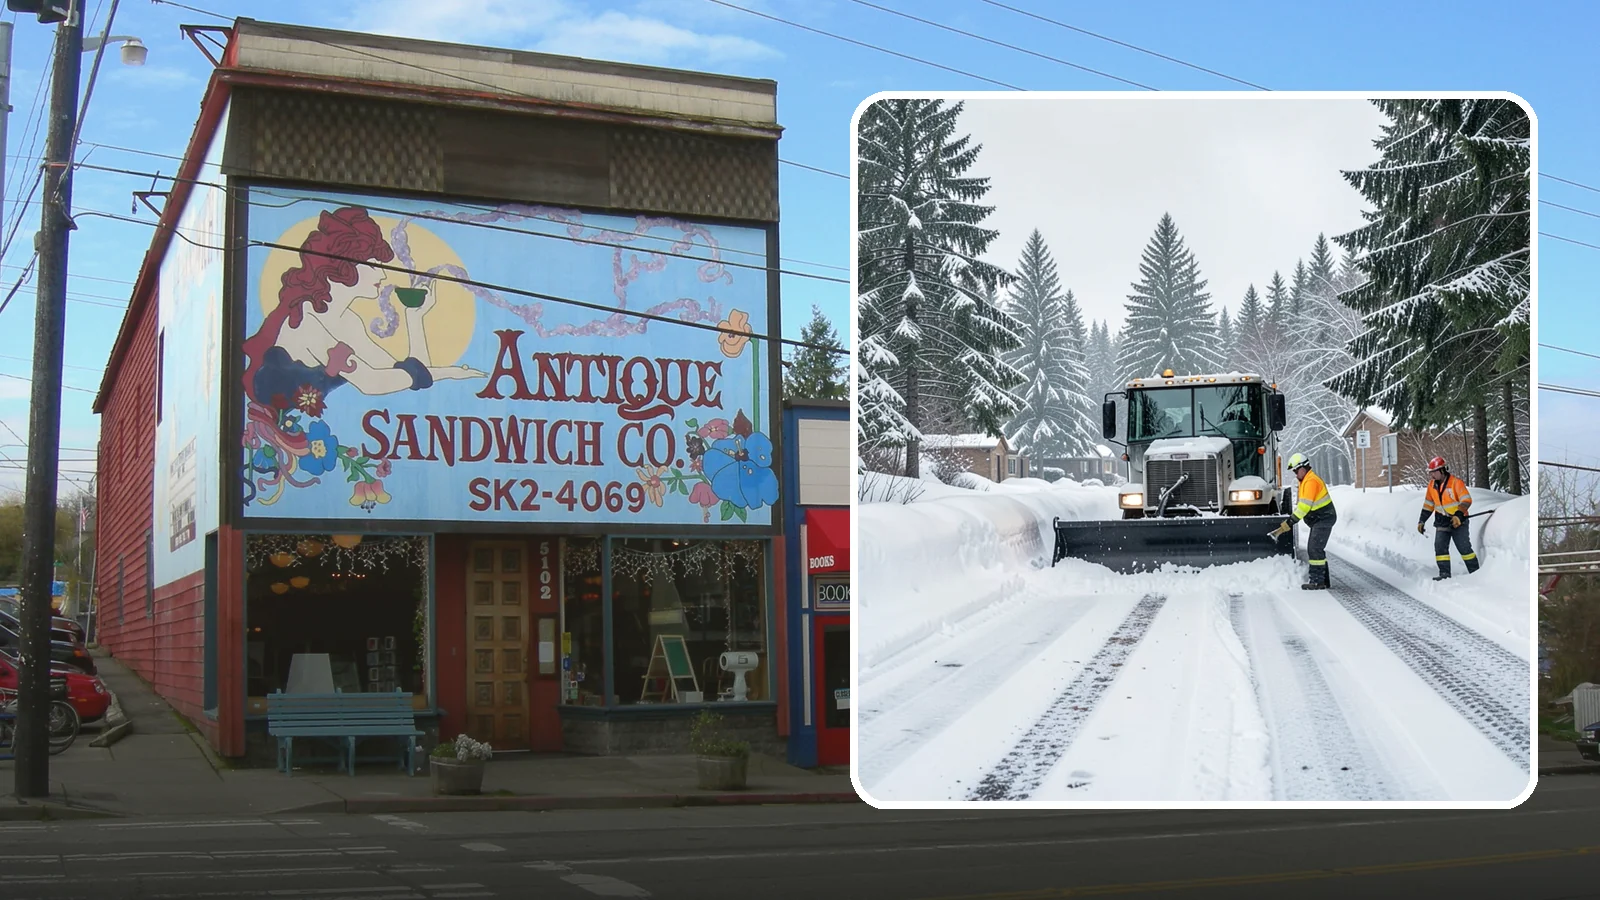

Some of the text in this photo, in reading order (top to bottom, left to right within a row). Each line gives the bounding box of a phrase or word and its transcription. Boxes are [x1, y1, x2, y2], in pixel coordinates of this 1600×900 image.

[475, 329, 723, 421] ANTIQUE
[361, 408, 684, 469] SANDWICH CO.
[468, 477, 646, 513] SK2-4069
[540, 541, 551, 600] 5102
[809, 555, 835, 569] BOOKS
